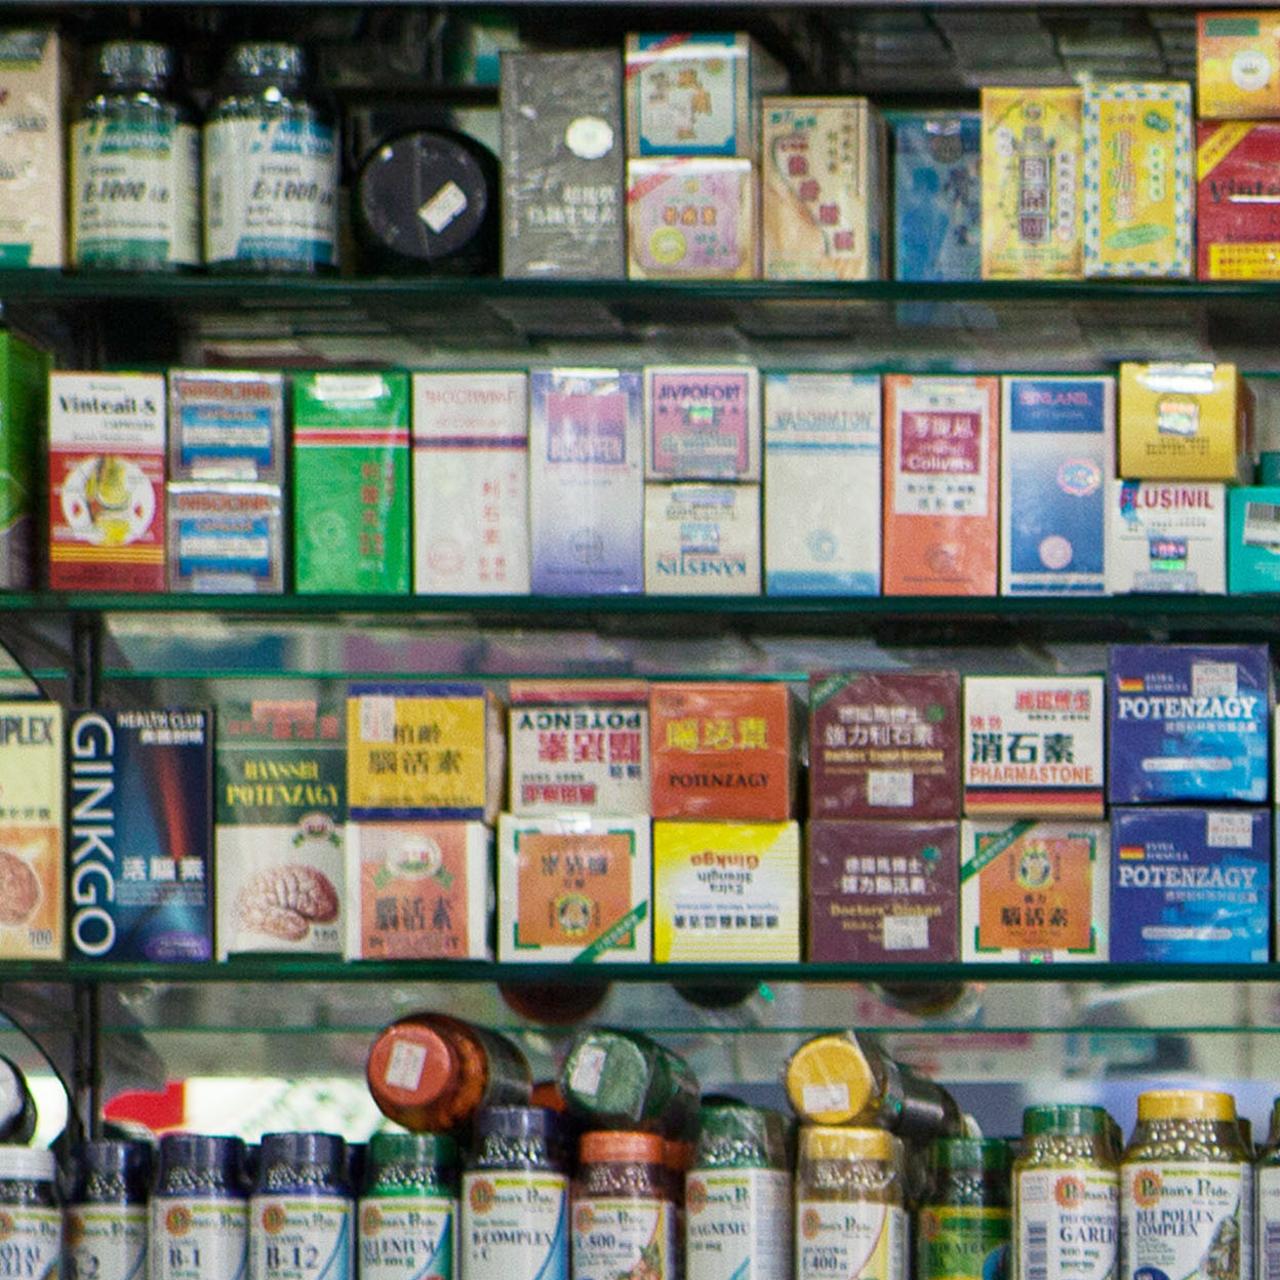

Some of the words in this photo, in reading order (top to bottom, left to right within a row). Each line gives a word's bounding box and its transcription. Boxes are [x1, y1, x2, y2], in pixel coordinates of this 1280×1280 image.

[1118, 697, 1257, 721] POTENZAGY
[519, 713, 642, 731] POTENCY
[971, 731, 1075, 765] 消石素
[970, 767, 1094, 785] PHARMASTONE
[70, 714, 116, 956] GINKGO
